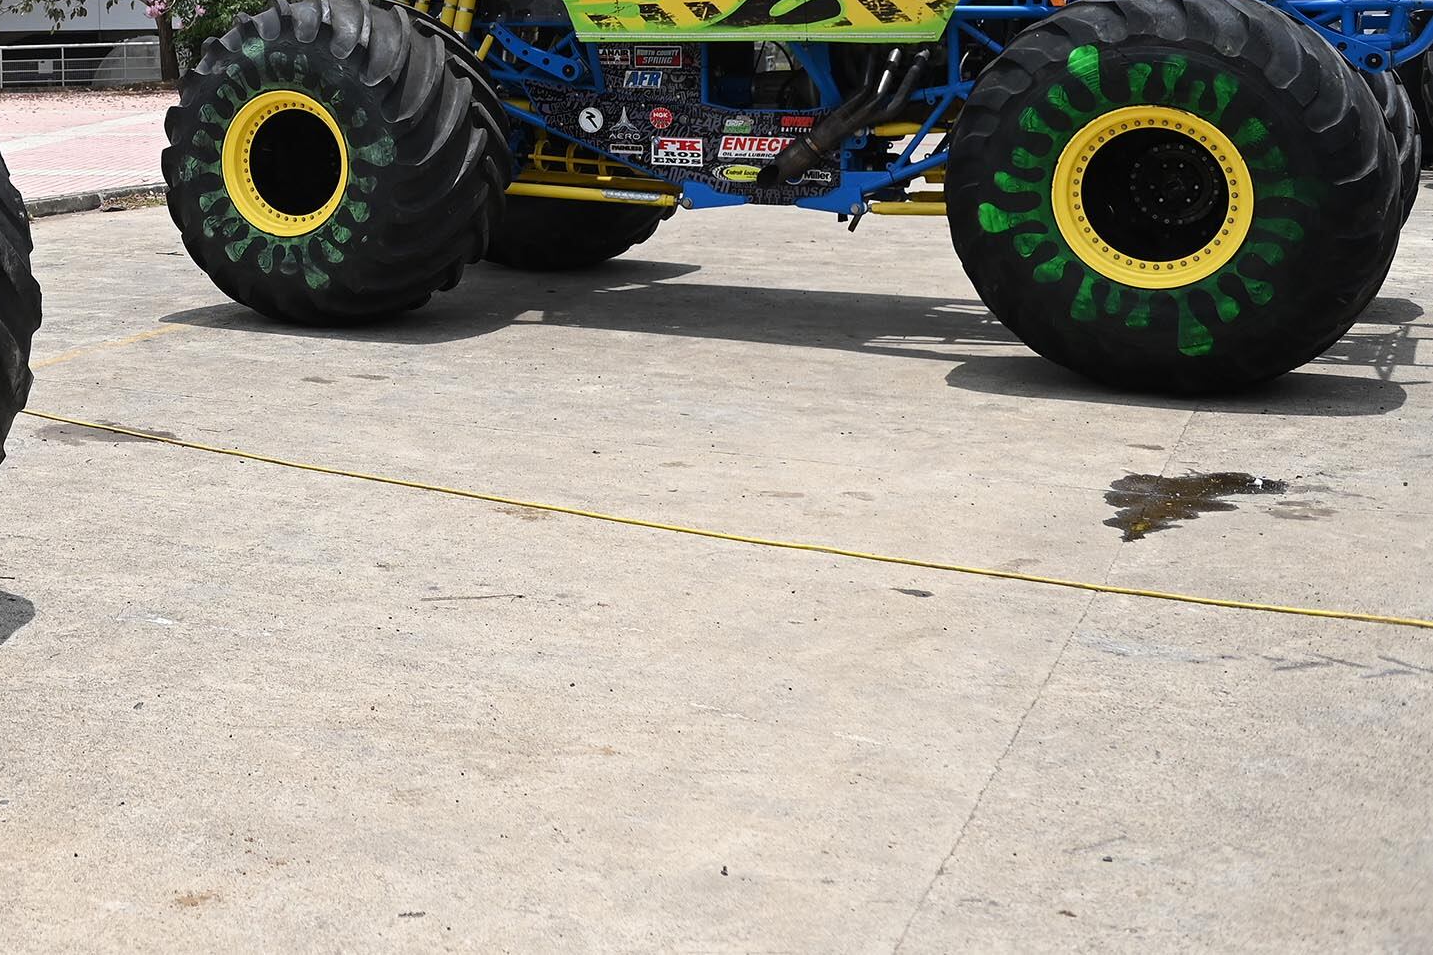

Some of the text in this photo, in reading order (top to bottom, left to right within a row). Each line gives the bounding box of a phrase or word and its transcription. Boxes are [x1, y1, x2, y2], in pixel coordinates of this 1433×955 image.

[642, 56, 673, 64] SPRING
[626, 71, 660, 87] AFR
[609, 132, 641, 140] AERO
[659, 140, 701, 151] FK
[804, 171, 830, 180] Miller
